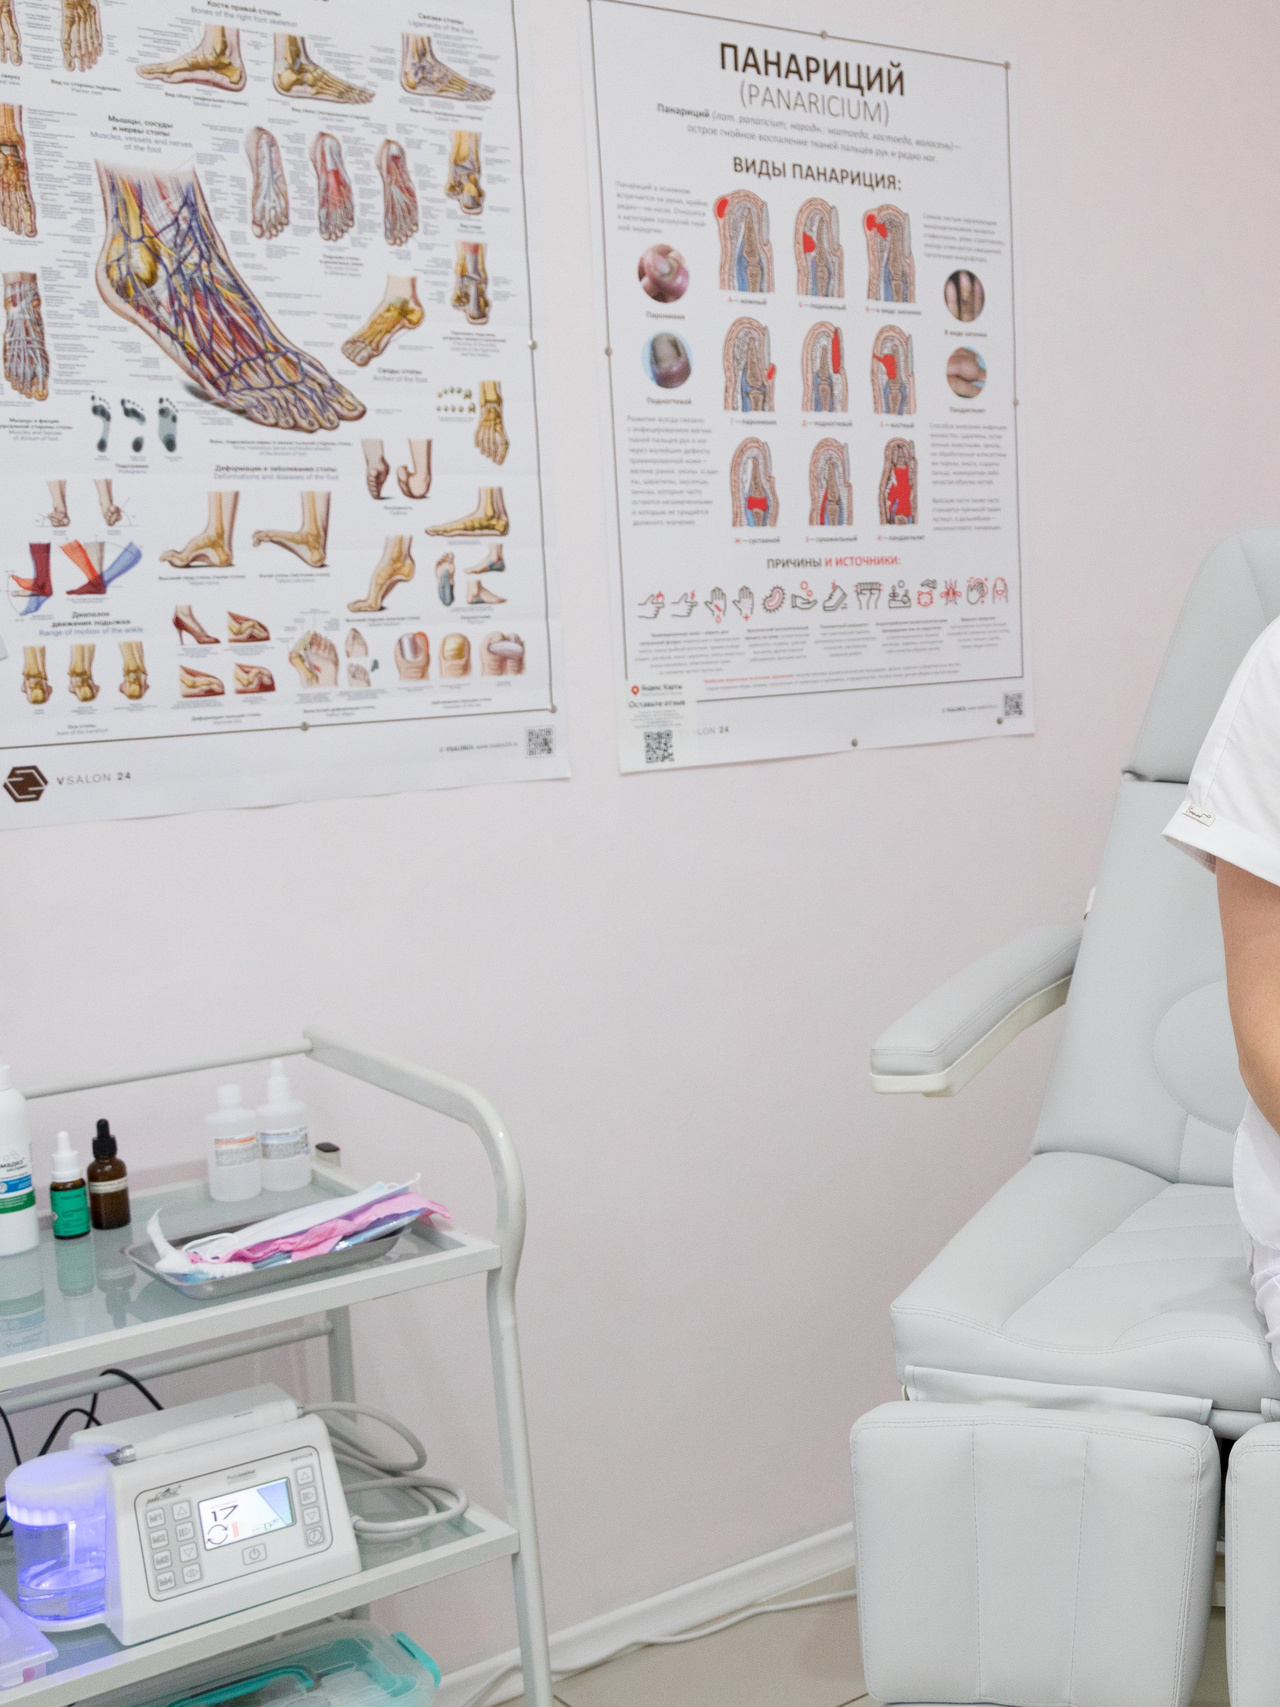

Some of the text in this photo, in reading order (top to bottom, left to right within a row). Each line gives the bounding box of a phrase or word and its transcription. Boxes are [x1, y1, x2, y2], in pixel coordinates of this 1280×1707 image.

[720, 42, 905, 97] ПАНАРИЦИЙ
[657, 102, 710, 118] Панариций
[740, 79, 890, 127] (PANARICIUM)
[732, 156, 902, 191] ВИДЫ ПАНАРИЦИЯ:
[767, 555, 901, 569] ПРИЧИНЫ И ИСТОЧНИКИ:
[718, 725, 730, 734] 24
[56, 771, 131, 786] VSALON 24
[211, 1504, 239, 1523] 17
